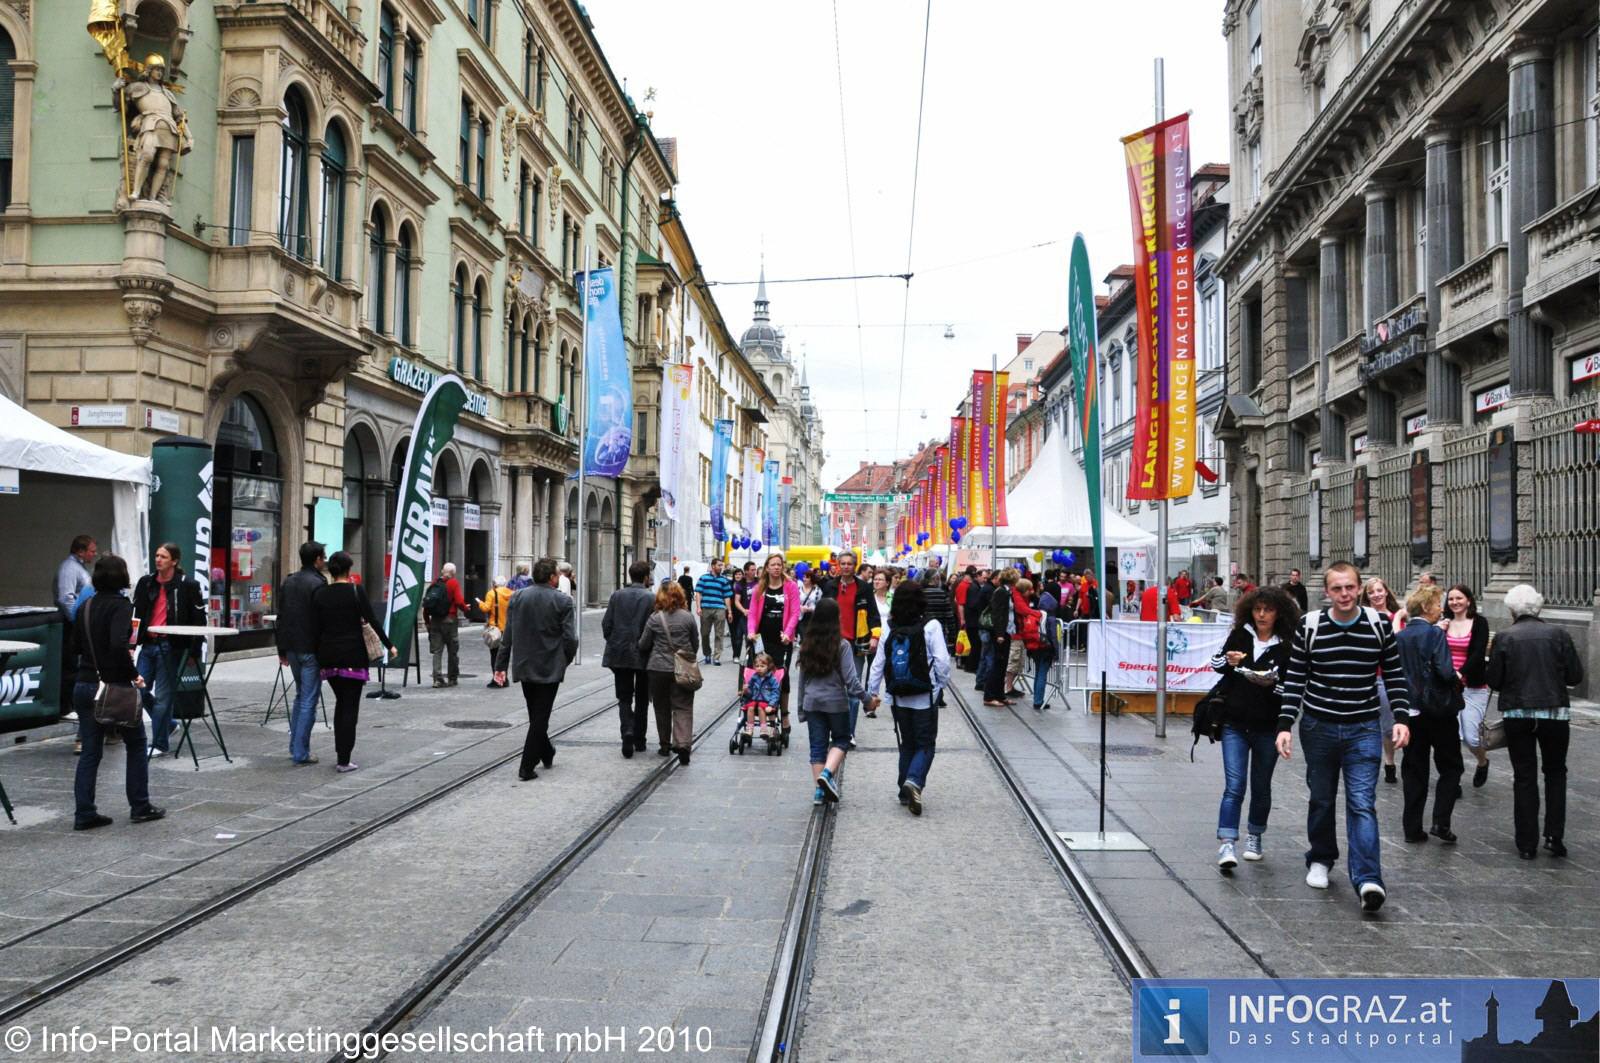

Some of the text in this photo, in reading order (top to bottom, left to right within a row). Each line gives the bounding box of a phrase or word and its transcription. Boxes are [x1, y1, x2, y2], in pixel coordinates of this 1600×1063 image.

[1140, 141, 1158, 489] LANGE NACHT DER KIRCHEN
[1171, 133, 1187, 488] WWW.LANGENACHTDERKIRCHEN.AT
[393, 357, 430, 393] GRAZER
[1490, 390, 1503, 404] Bank
[1117, 661, 1217, 675] Specia Olympic
